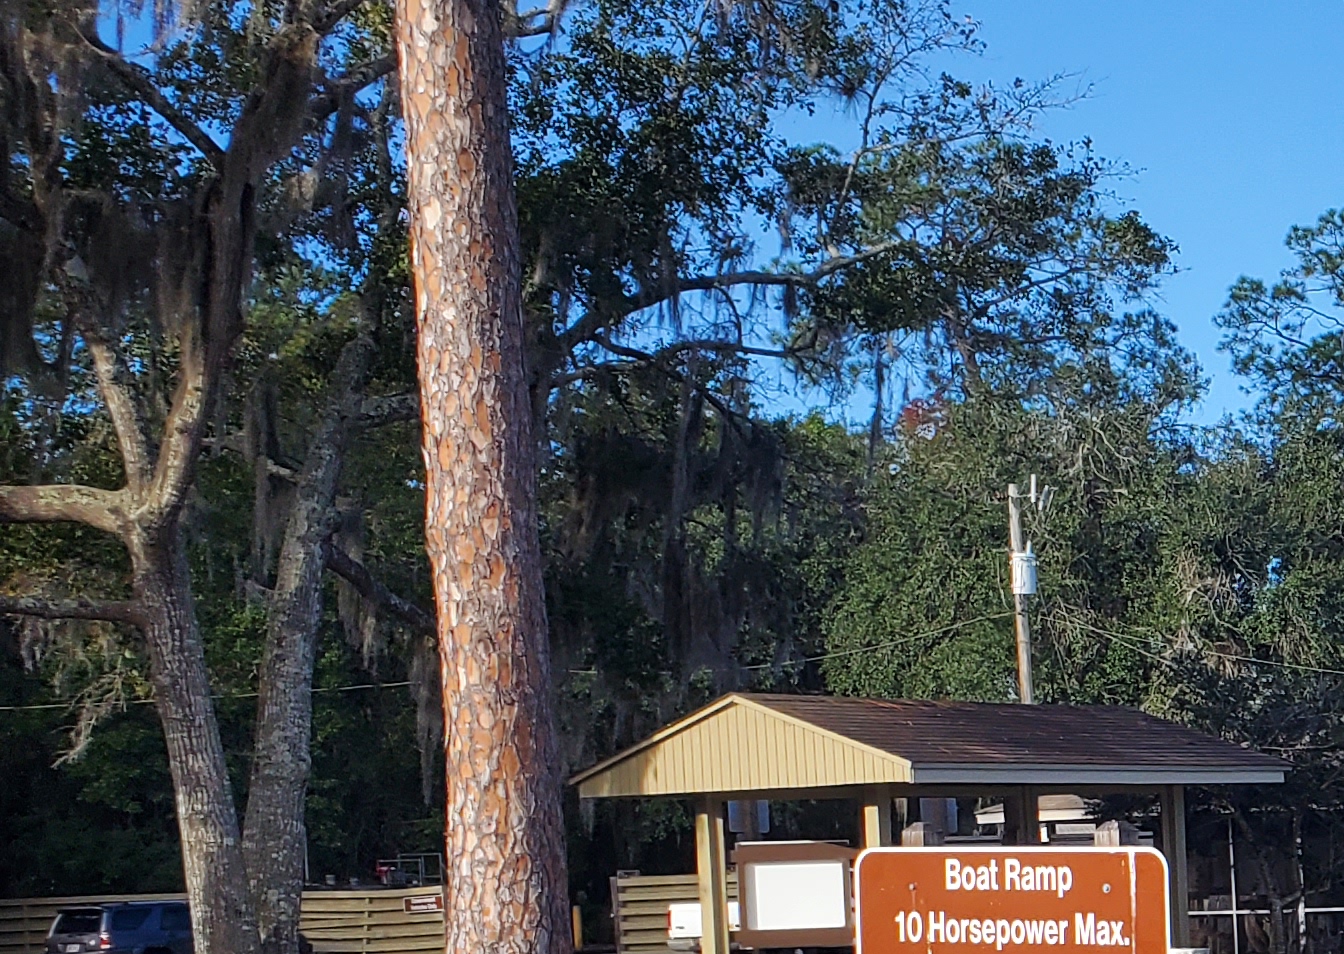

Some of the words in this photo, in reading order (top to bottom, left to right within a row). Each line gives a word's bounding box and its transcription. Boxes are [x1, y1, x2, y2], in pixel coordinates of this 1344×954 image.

[945, 858, 998, 891] Boat
[1004, 858, 1073, 898] Ramp
[895, 910, 923, 943] 10
[928, 911, 1068, 951] Horsepower
[1074, 912, 1130, 946] Max.
